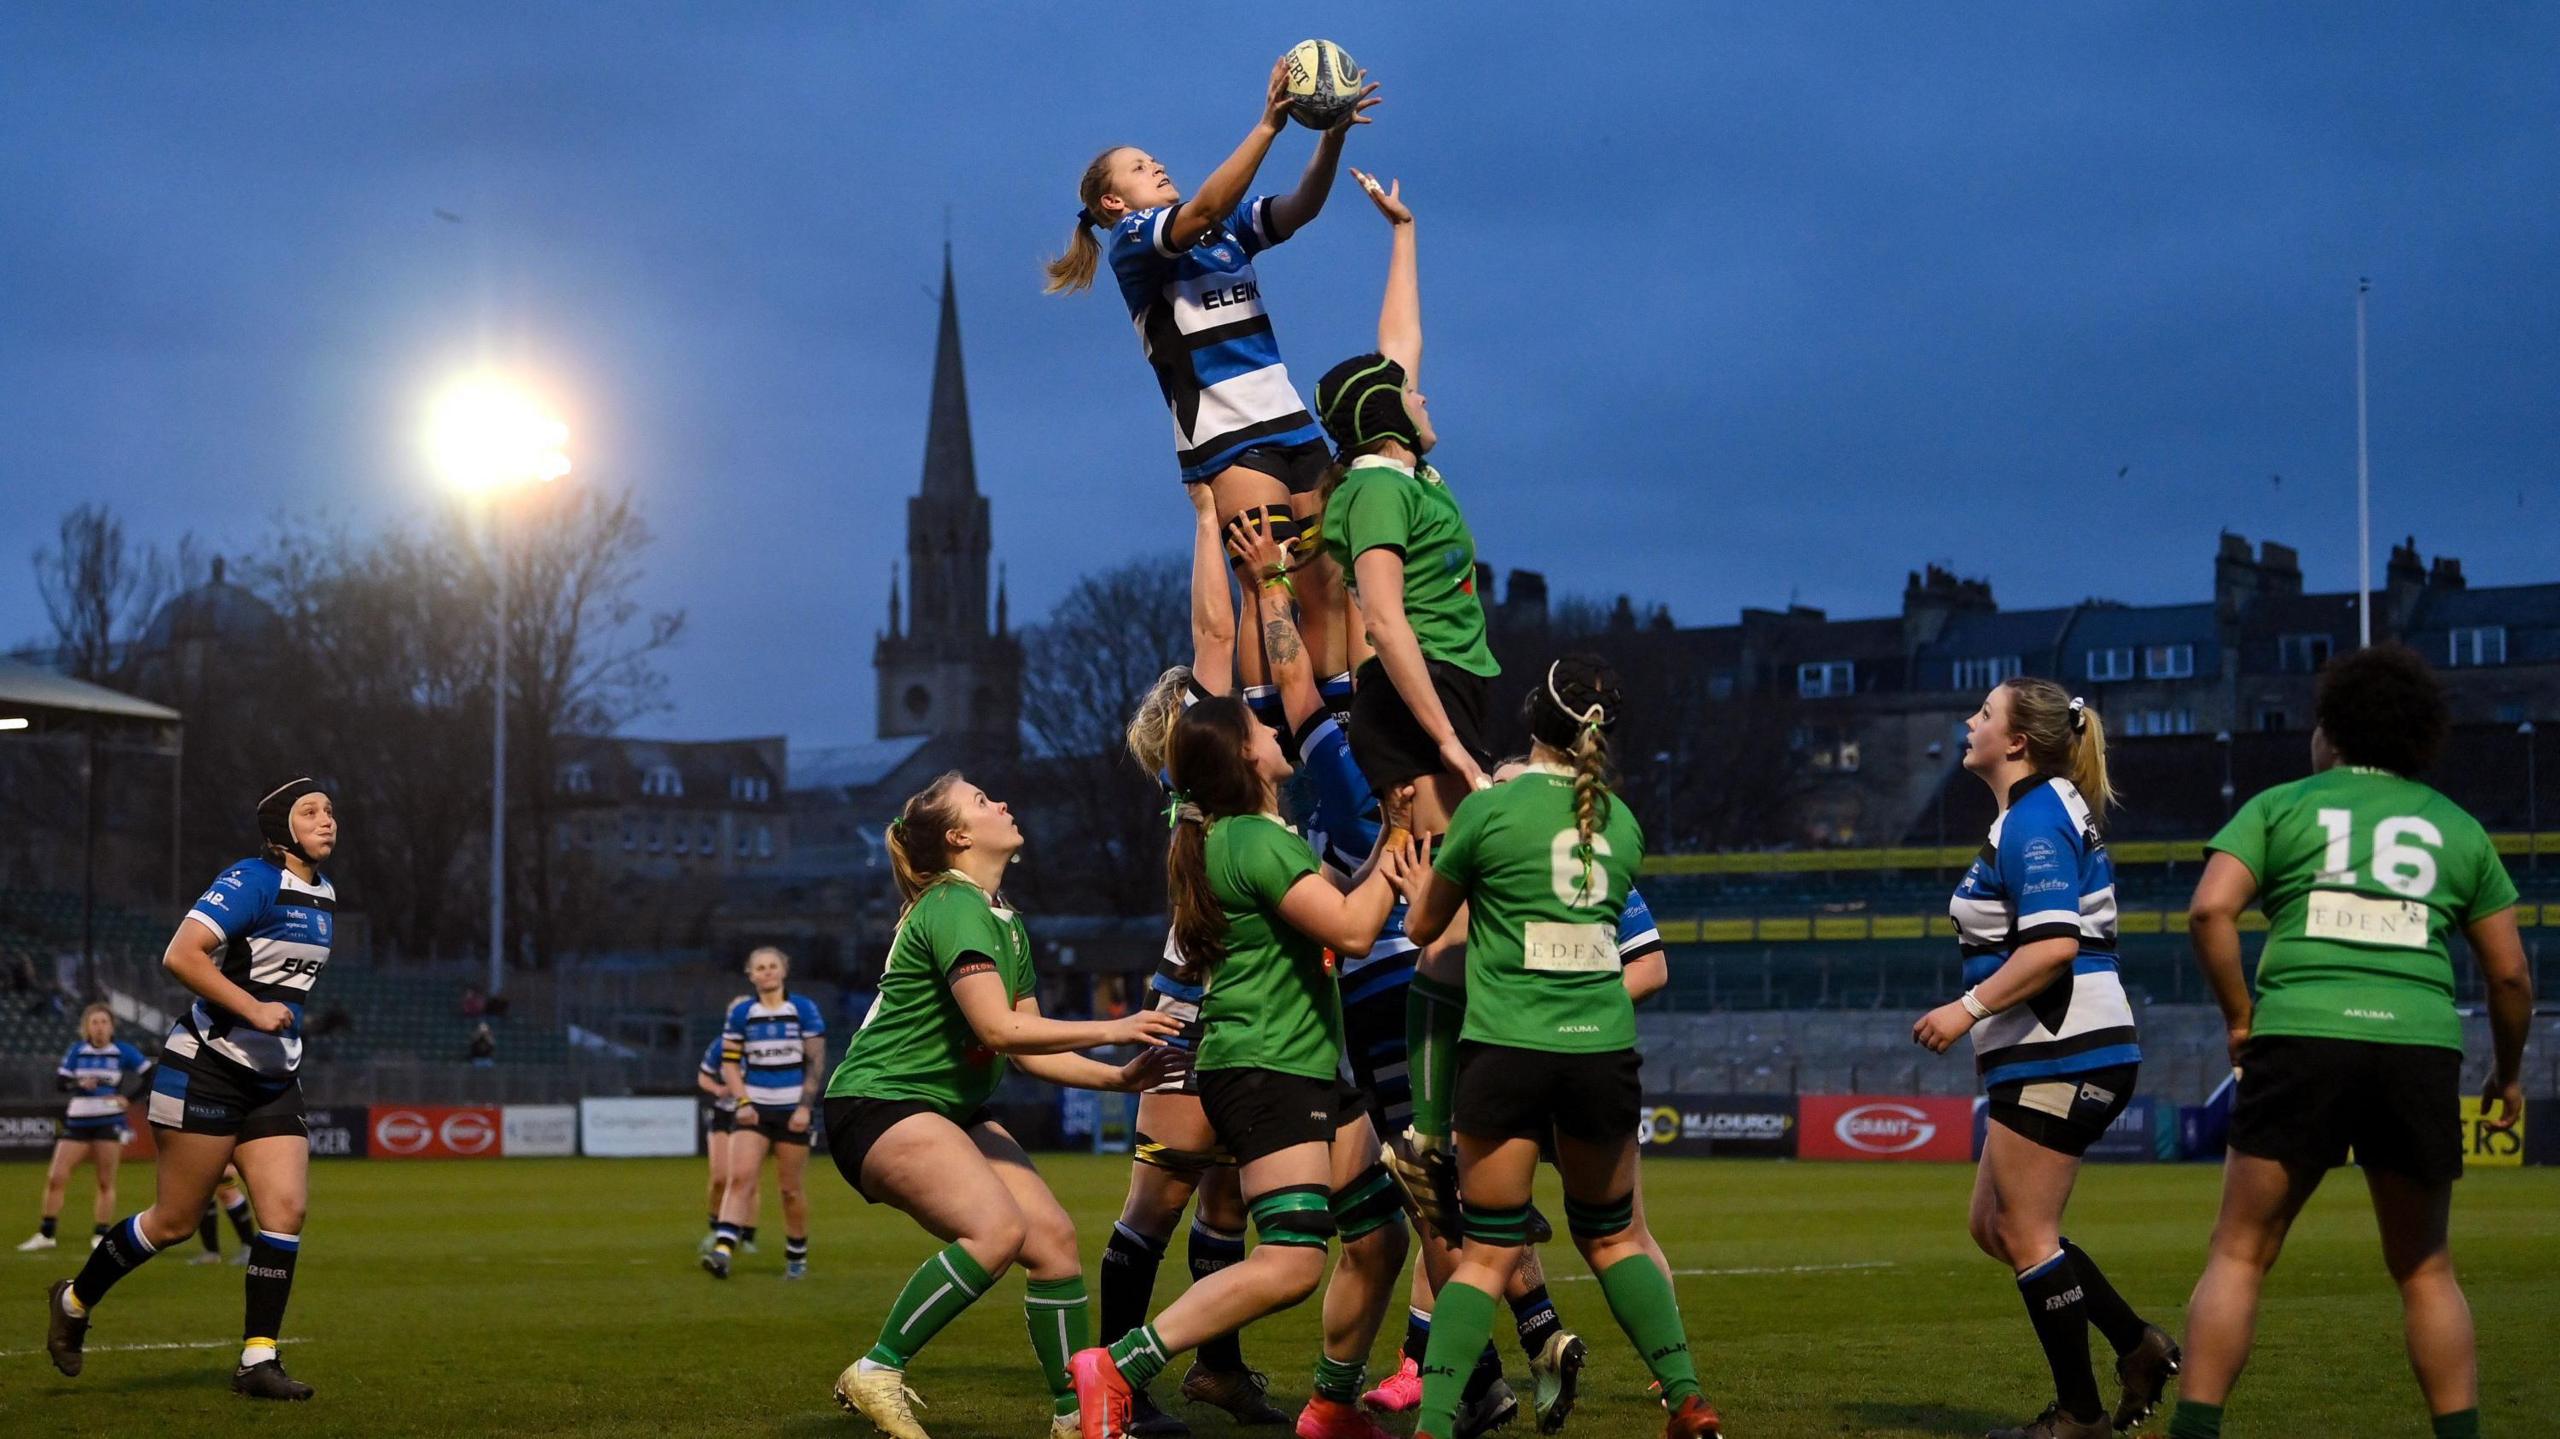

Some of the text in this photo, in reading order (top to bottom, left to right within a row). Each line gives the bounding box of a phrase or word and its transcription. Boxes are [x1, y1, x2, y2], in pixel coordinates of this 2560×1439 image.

[2313, 807, 2443, 898] 16
[1551, 826, 1613, 908] 6
[2315, 909, 2397, 932] EDEN
[1532, 943, 1607, 958] EDEN
[2344, 1008, 2395, 1020] AKUMA
[1558, 1025, 1600, 1033] AKUMA
